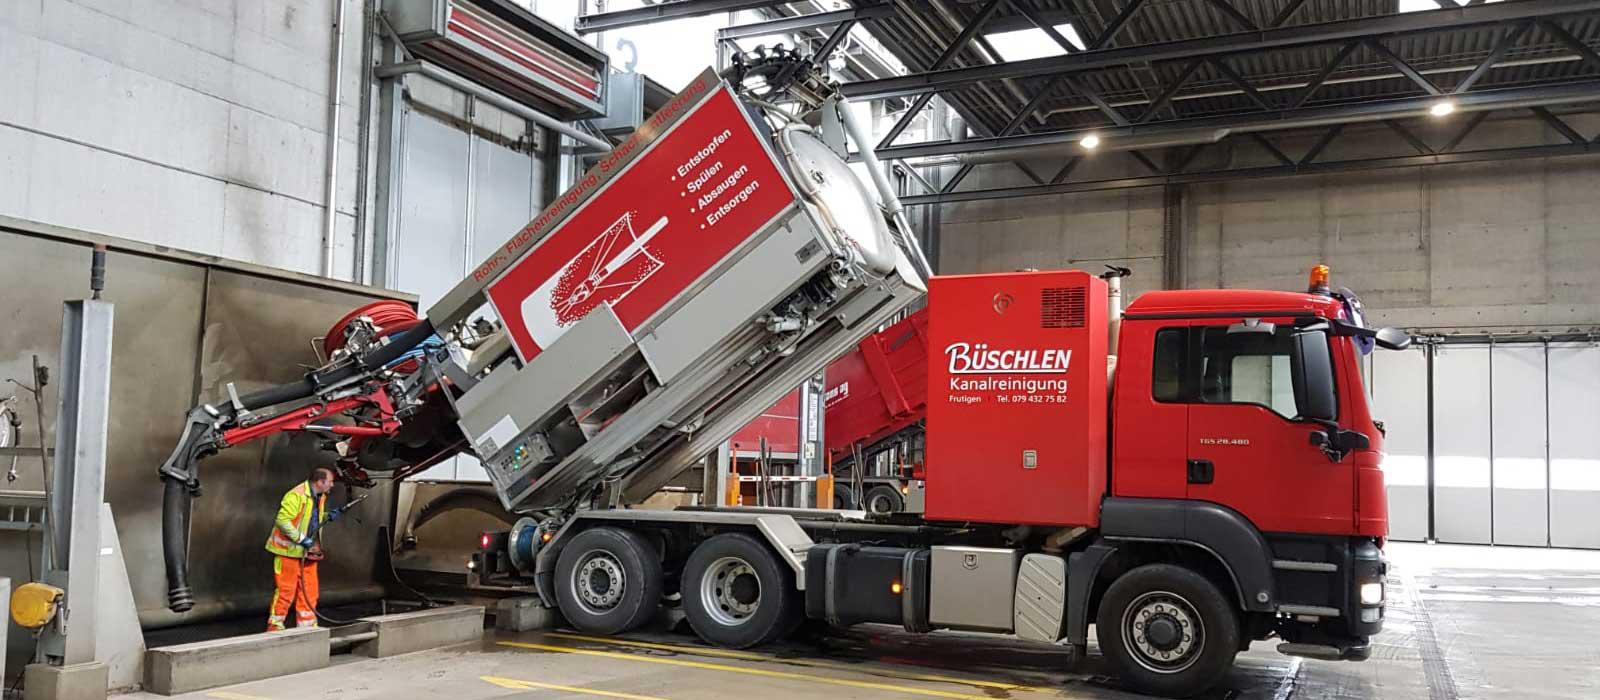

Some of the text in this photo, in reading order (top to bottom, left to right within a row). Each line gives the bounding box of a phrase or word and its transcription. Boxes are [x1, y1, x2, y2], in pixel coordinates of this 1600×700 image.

[676, 127, 733, 178] Entstopfen
[686, 160, 724, 194] Spülen
[696, 163, 749, 211] Absaugen
[706, 179, 760, 226] Entsorgen
[945, 342, 1073, 374] BÜSCHLEN
[949, 395, 1067, 404] Frutigen Tel. 079 432 75 82
[950, 377, 1068, 394] Kanalreinigung
